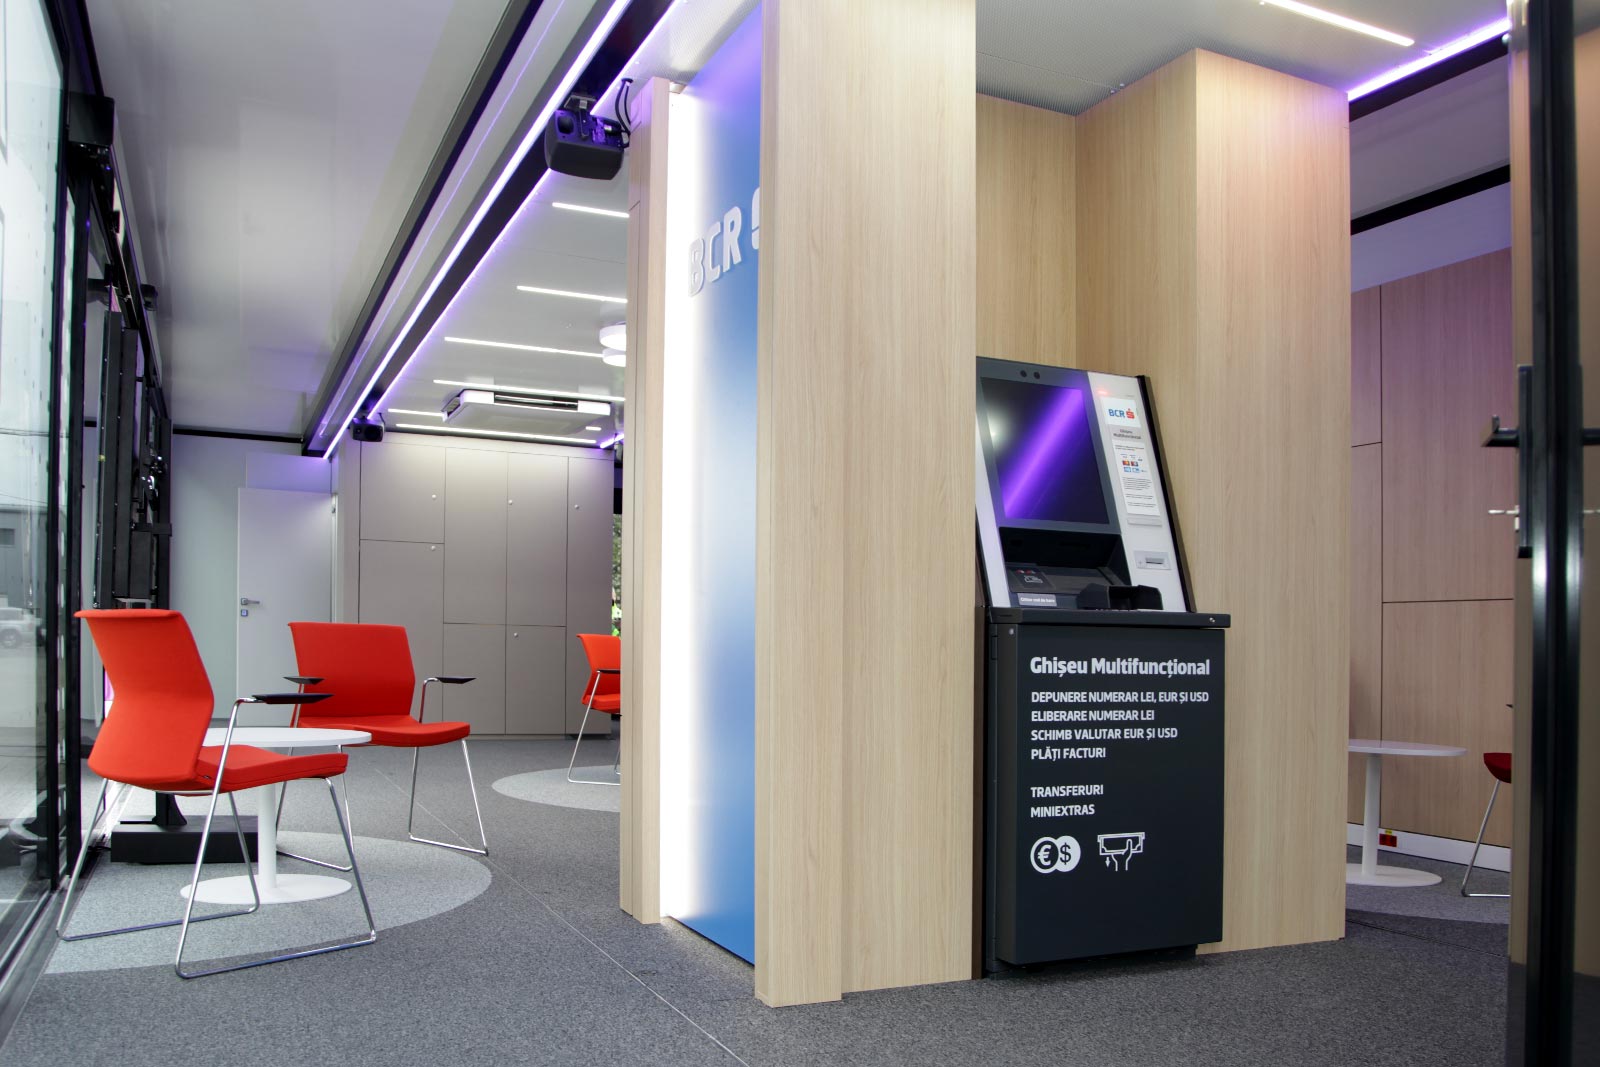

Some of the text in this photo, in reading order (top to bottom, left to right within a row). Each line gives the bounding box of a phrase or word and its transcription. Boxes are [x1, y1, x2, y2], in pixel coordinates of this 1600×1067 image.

[688, 206, 742, 297] BCR
[1108, 408, 1125, 418] BCR
[1030, 656, 1210, 679] Ghișeu Multifuncțional
[1031, 691, 1210, 705] DEPUNERE NUMERAR LEI, EUR ȘI USD
[1031, 709, 1155, 722] ELIBERARE NUMERAR LEI
[1030, 727, 1178, 741] SCHIMB VALUTAR EUR ȘI USD
[1030, 746, 1106, 762] PLĂȚI FACTURI
[1030, 784, 1104, 798] TRANSFERURI
[1030, 803, 1096, 818] MINIEXTRAS
